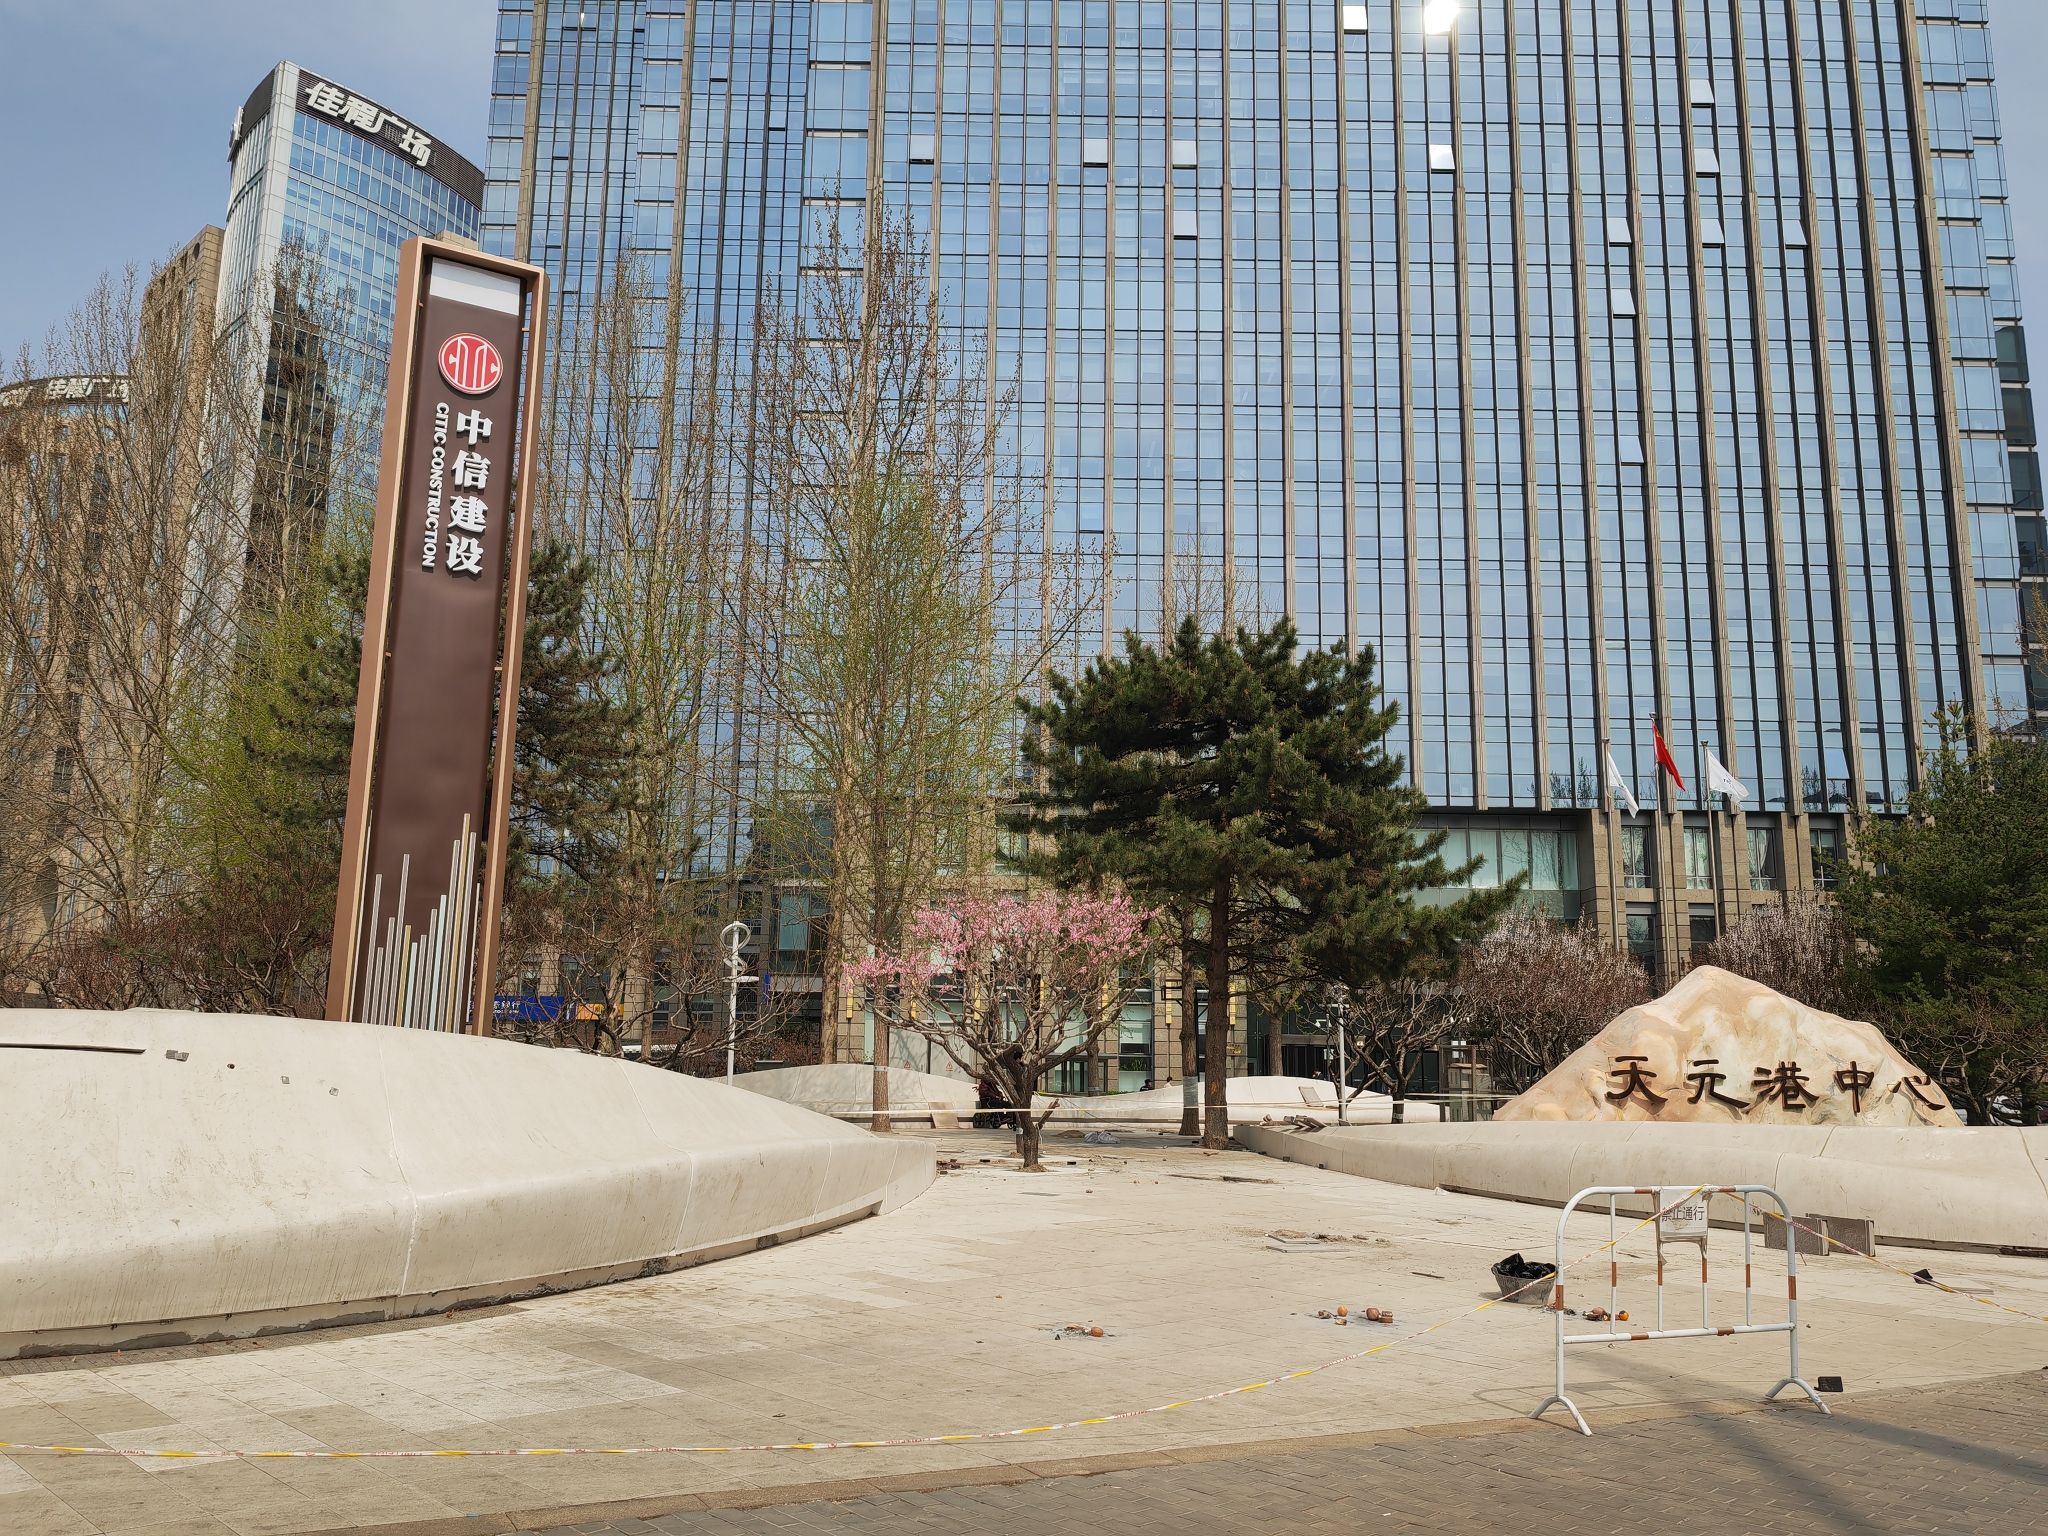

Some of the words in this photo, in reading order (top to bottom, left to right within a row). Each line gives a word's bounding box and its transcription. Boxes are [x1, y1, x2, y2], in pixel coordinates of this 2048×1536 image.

[305, 82, 432, 167] 佳程广场
[434, 402, 450, 444] CITIC
[422, 446, 446, 568] CONSTRUCTION
[445, 409, 493, 574] 中信建设
[1604, 1056, 1946, 1114] 天元港中心
